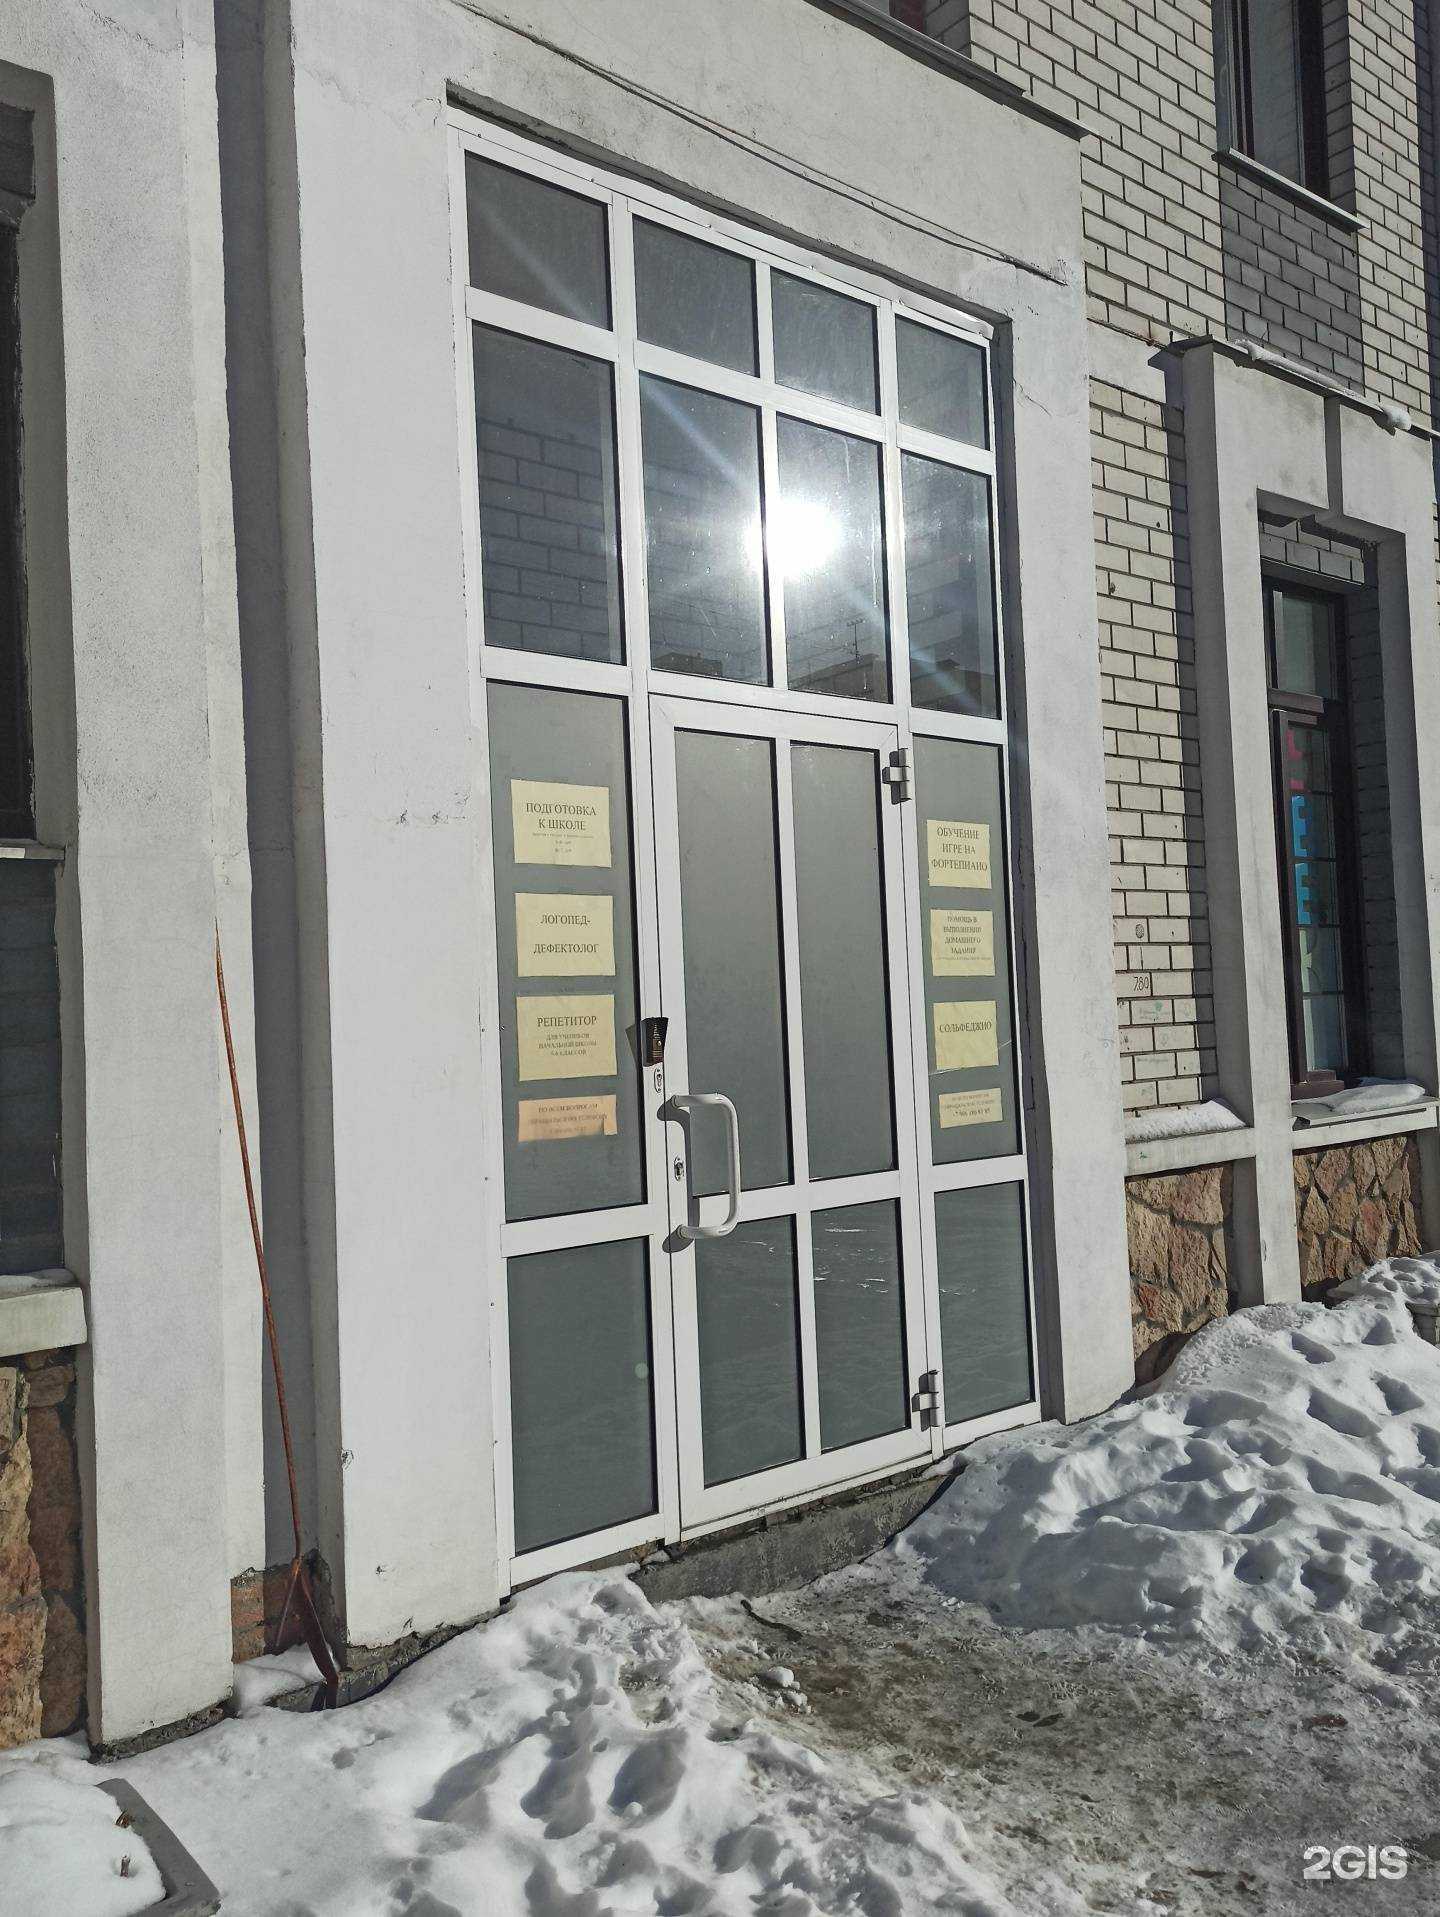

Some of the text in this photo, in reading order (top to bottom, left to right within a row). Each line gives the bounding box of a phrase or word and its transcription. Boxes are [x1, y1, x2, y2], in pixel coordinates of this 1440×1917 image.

[525, 802, 597, 816] ПОДГОТОВКА
[538, 818, 587, 831] К ШКОЛЕ
[936, 827, 980, 840] ОБУЧЕНИЕ
[942, 843, 976, 855] ИГРЕ НА
[931, 859, 988, 872] ФОРТЕПИАНО
[540, 914, 591, 926] ЛОГОПЕД-
[533, 943, 599, 954] ДЕФЕКТОЛОГ
[537, 1015, 597, 1028] РЕПЕТИТОР
[939, 1020, 992, 1033] СОЛЬФЕДЖИО
